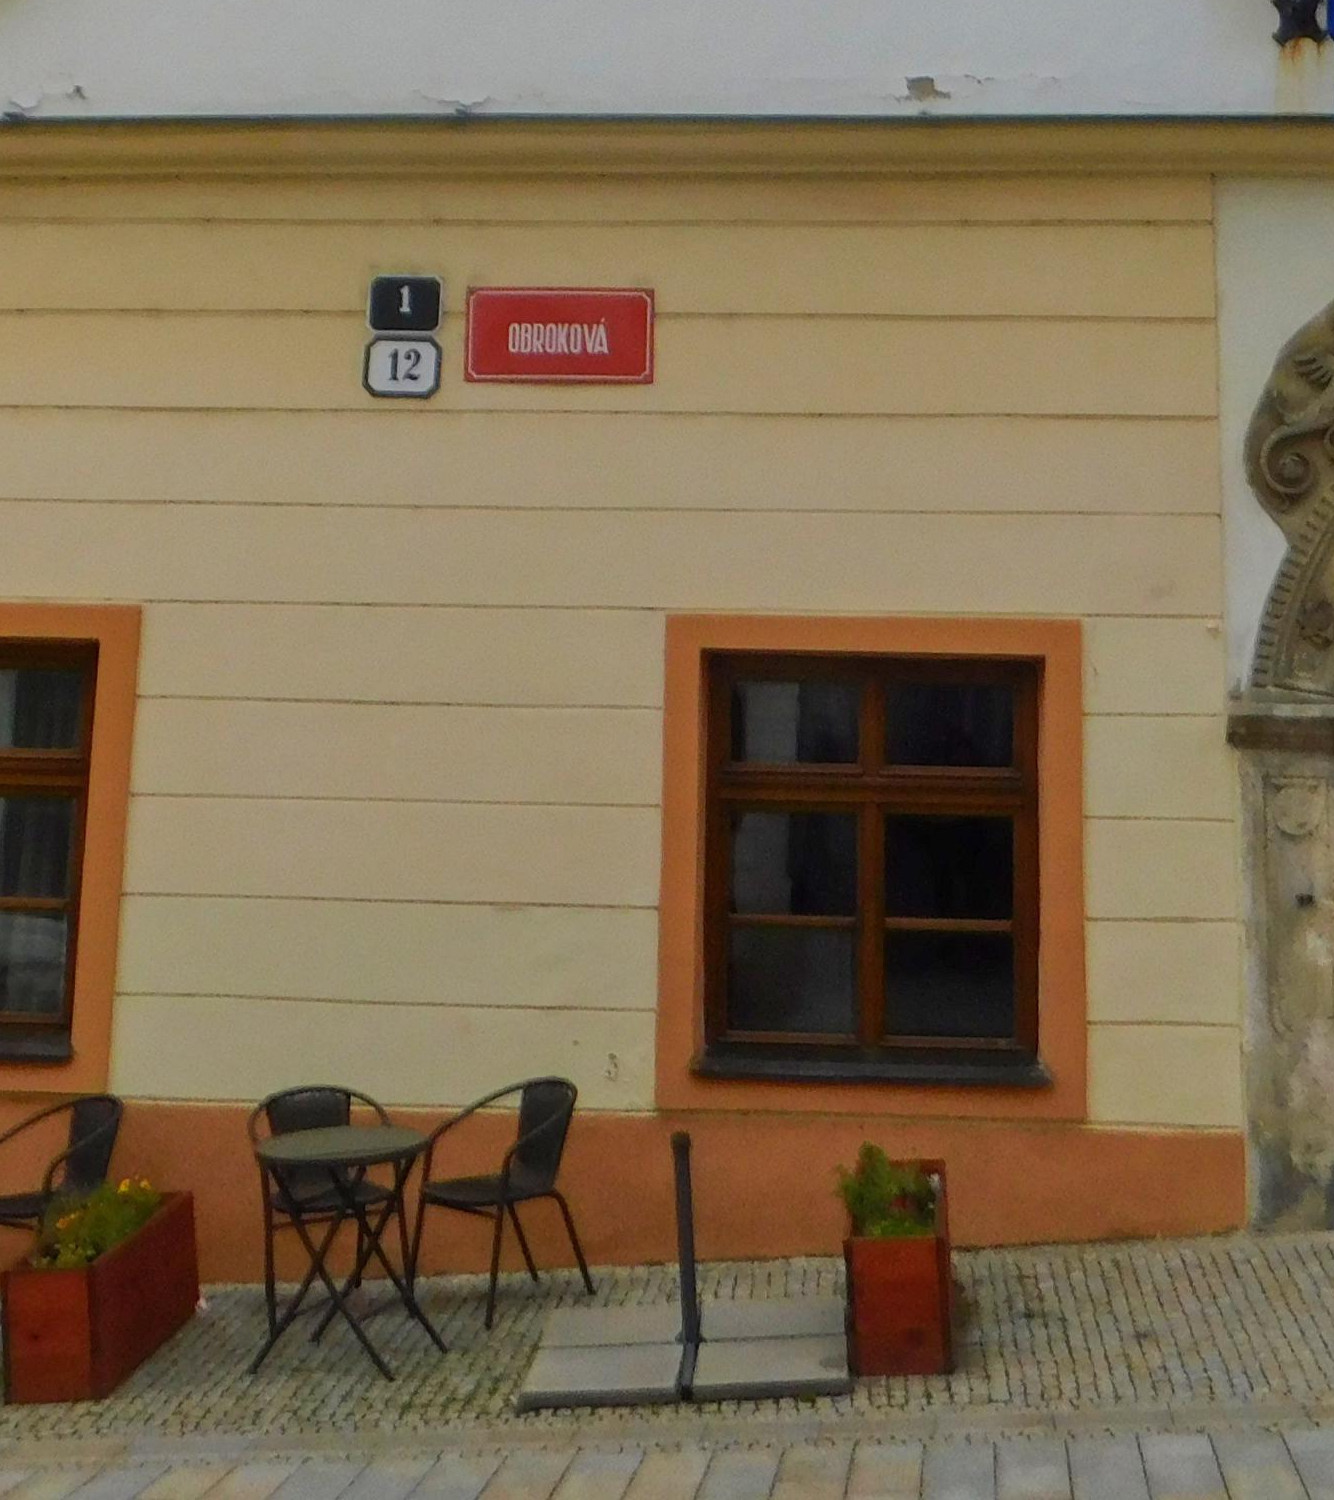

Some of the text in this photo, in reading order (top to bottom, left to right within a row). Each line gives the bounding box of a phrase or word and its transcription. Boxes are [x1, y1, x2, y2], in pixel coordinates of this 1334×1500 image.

[399, 285, 412, 314] 1
[508, 317, 609, 354] OBROKOVÁ
[388, 348, 422, 381] 12
